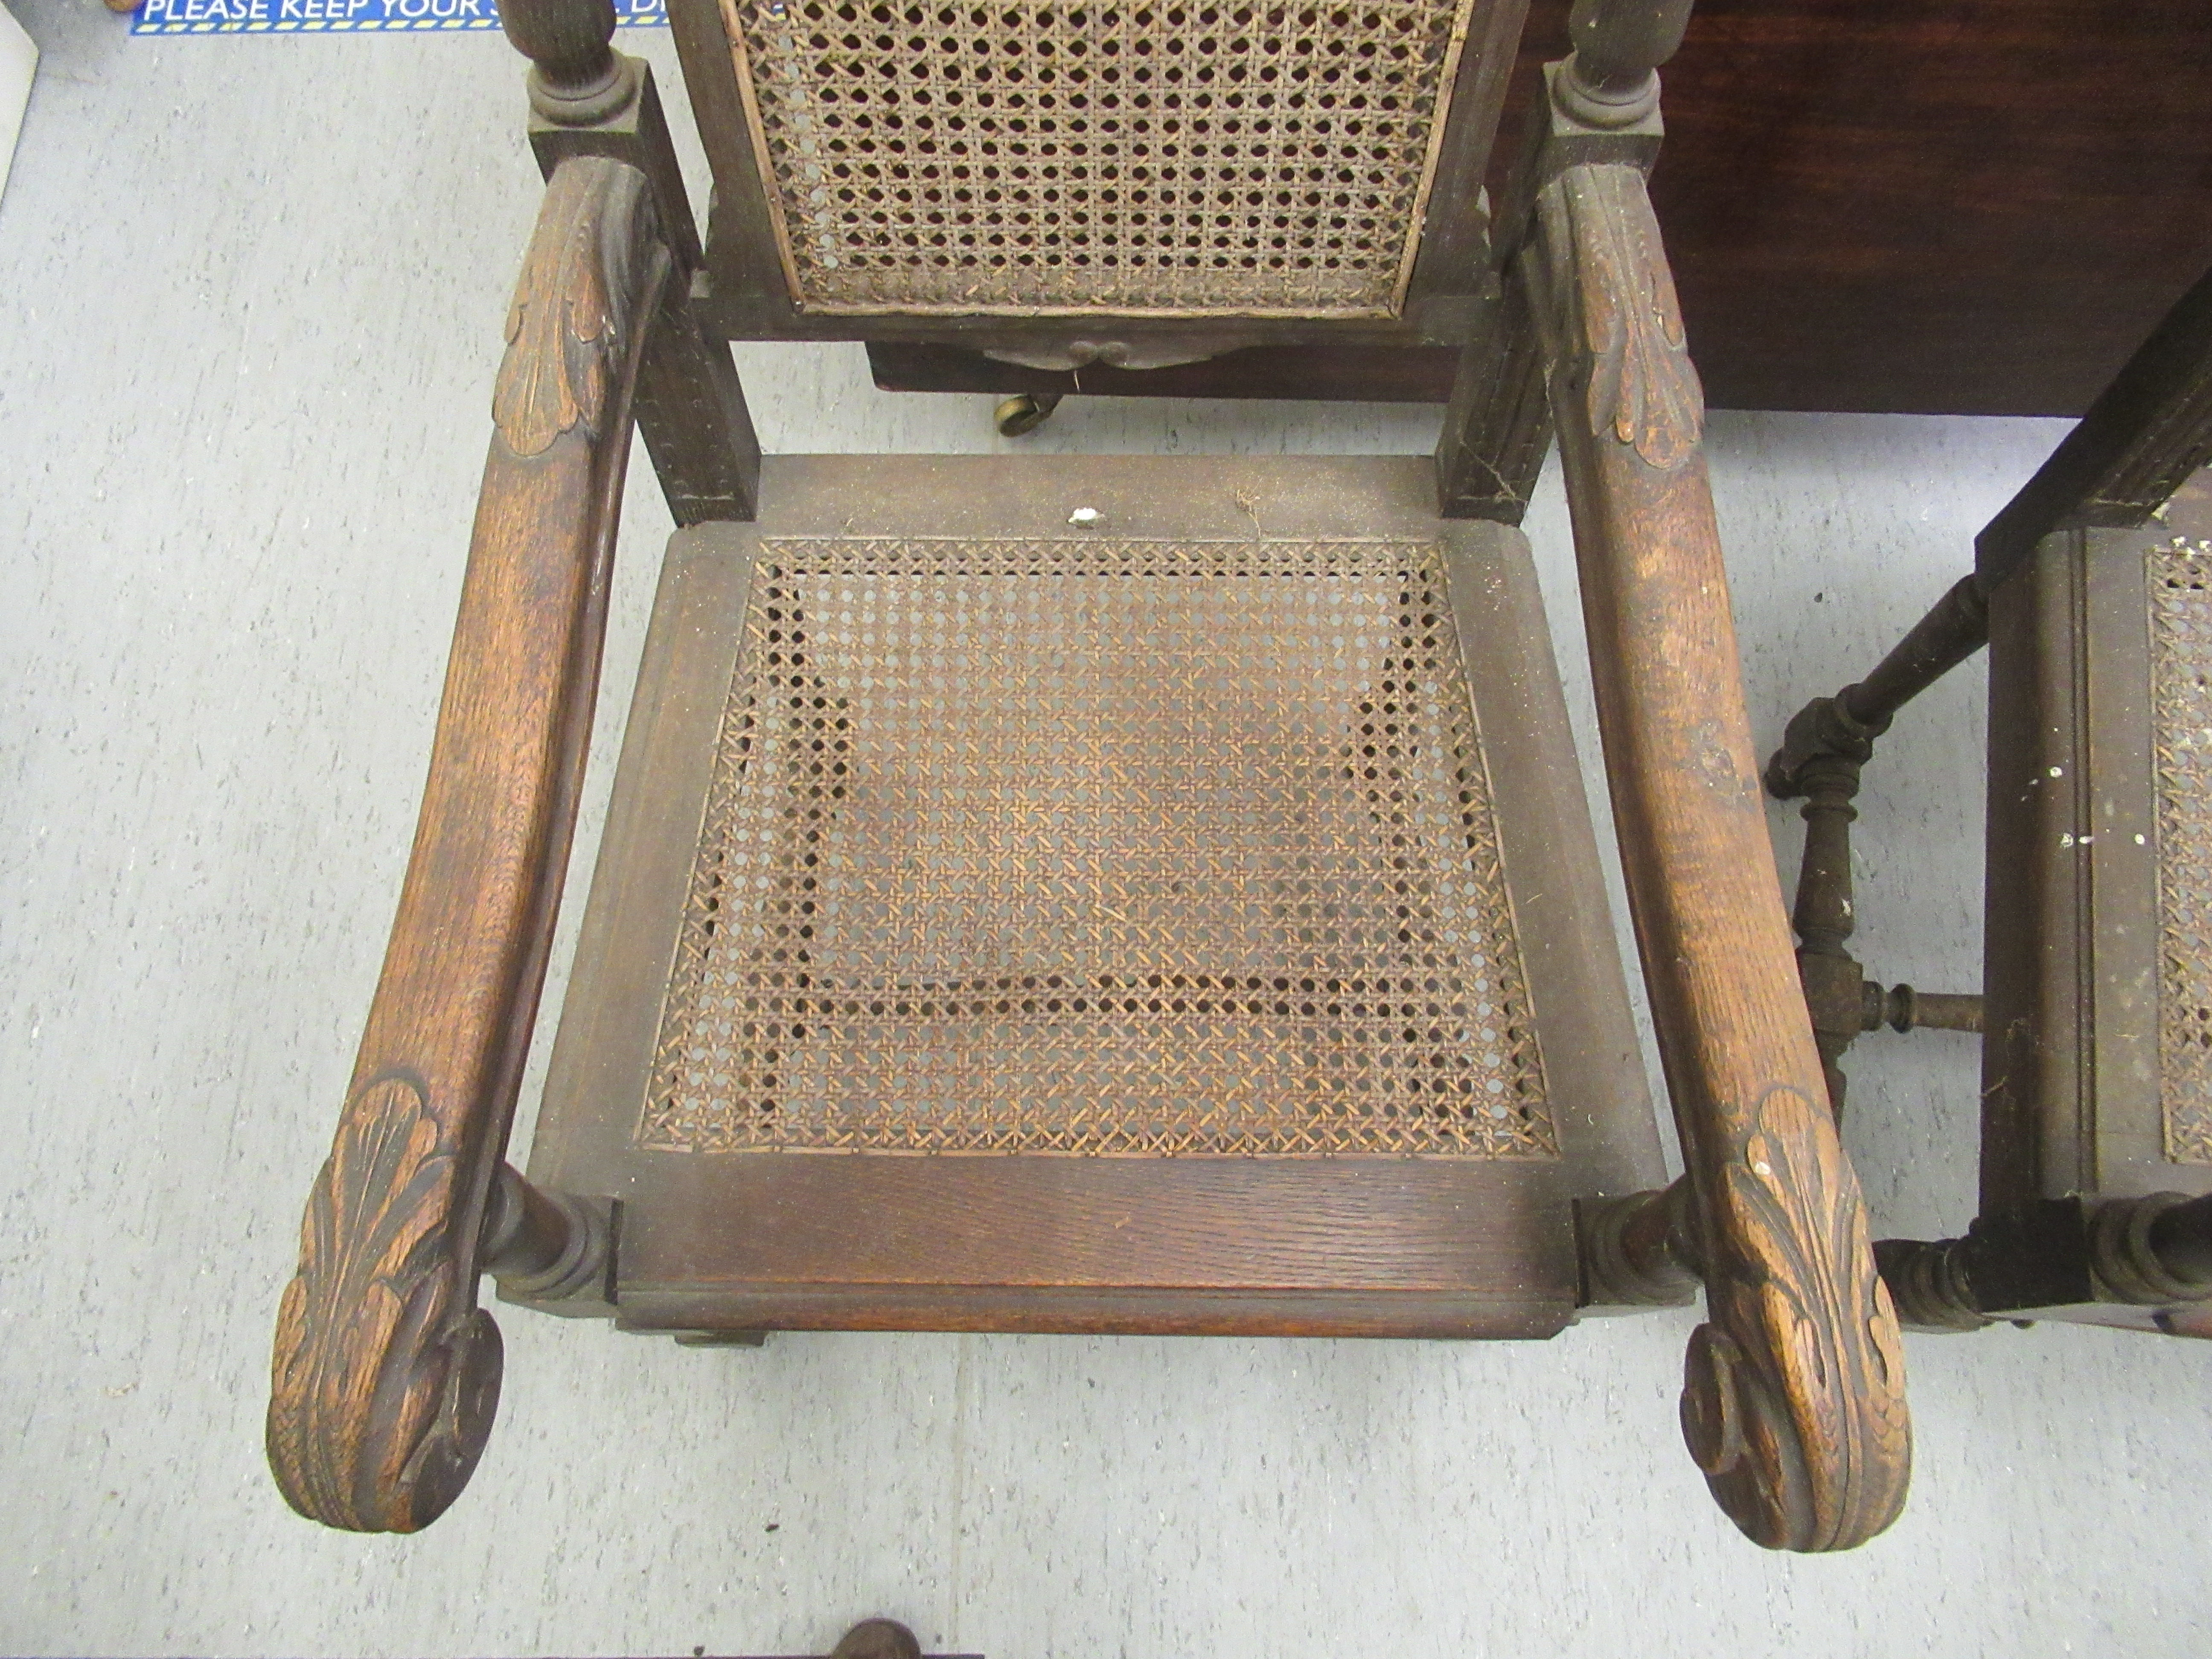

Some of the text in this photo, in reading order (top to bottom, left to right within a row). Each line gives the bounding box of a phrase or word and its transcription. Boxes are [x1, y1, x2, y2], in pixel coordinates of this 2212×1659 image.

[143, 0, 269, 20] PLEASE
[280, 0, 370, 18] KEEP
[381, 0, 480, 17] YOUR
